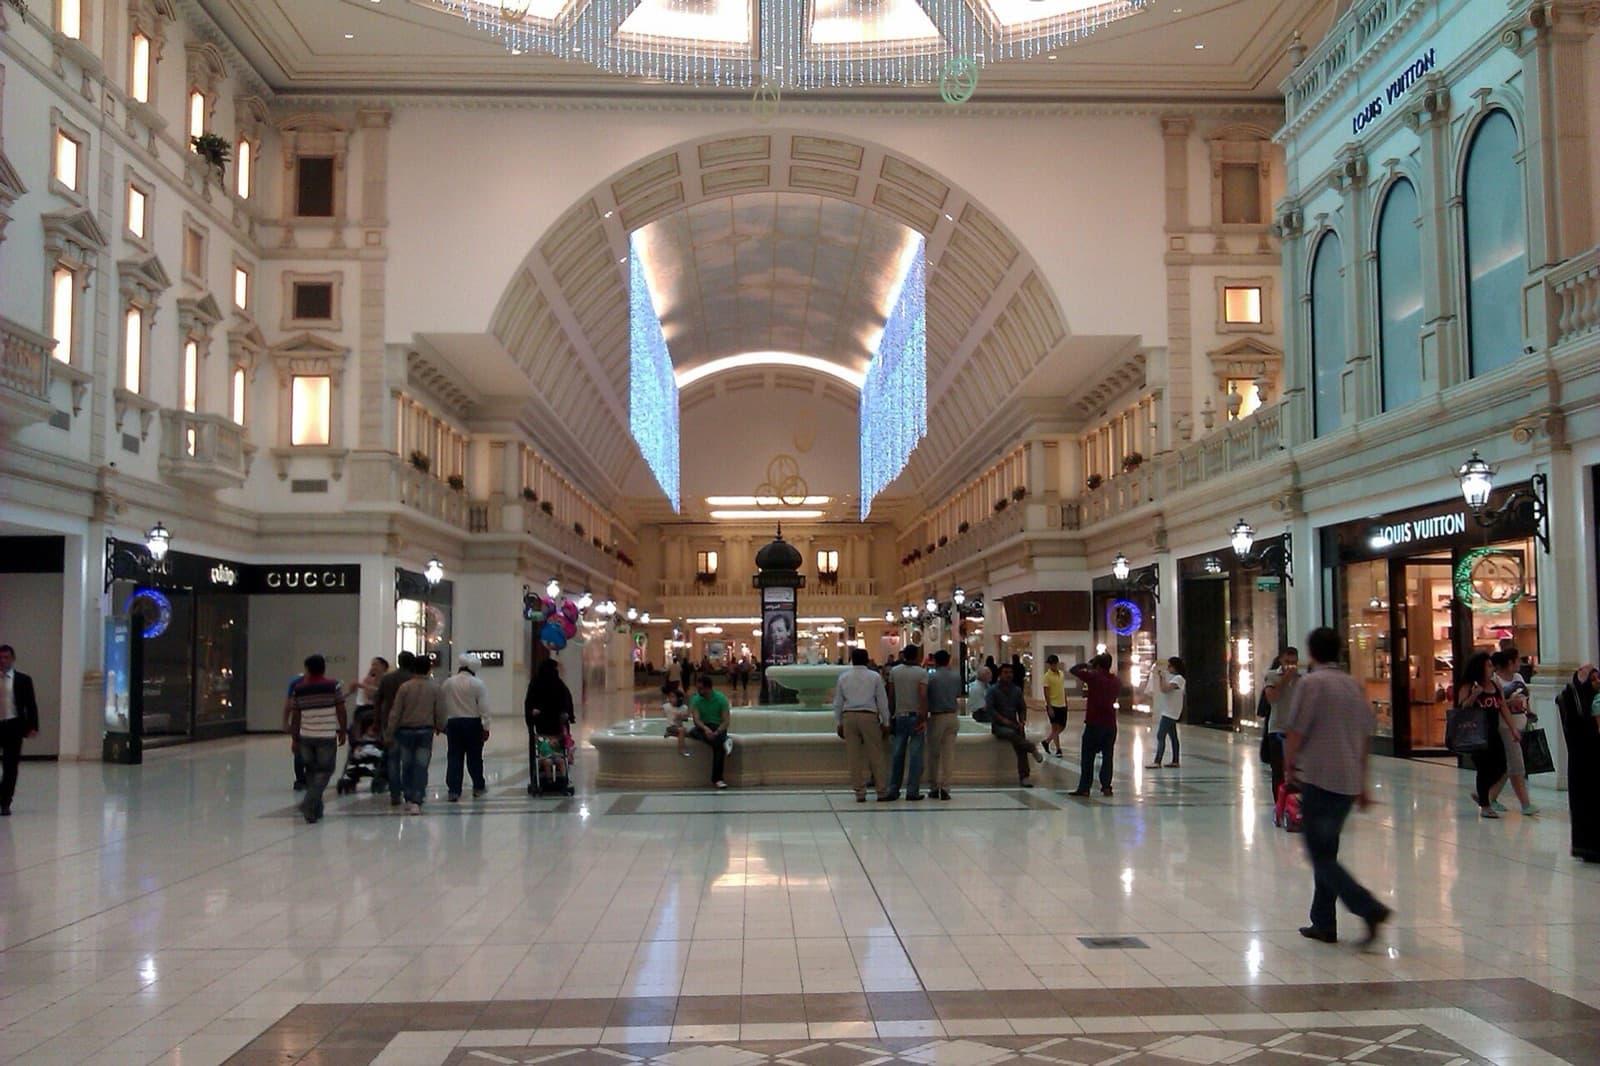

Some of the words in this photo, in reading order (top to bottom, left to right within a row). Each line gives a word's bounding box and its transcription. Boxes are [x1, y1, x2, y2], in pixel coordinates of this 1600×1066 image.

[1353, 97, 1382, 134] LOUIS
[1386, 48, 1435, 105] VUITTON
[1377, 522, 1411, 545] LOUIS
[1413, 512, 1465, 540] VUITTON
[266, 572, 345, 588] GUCCI
